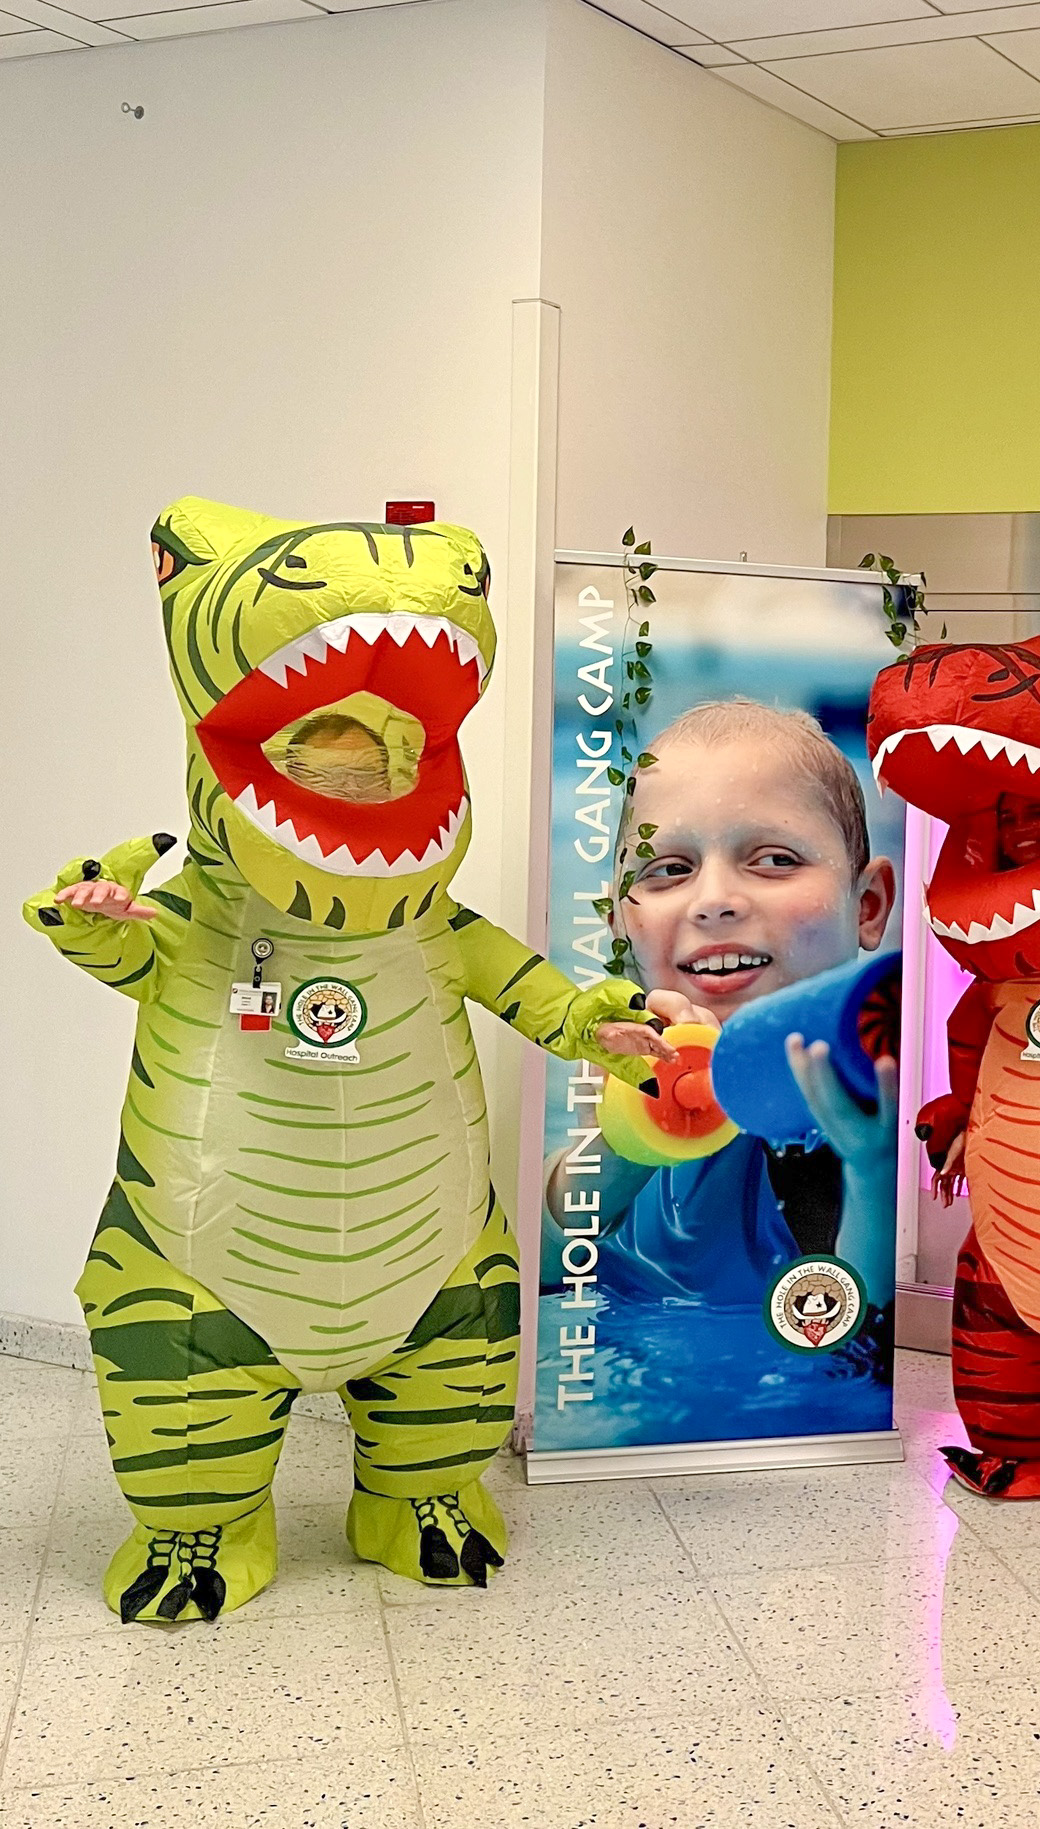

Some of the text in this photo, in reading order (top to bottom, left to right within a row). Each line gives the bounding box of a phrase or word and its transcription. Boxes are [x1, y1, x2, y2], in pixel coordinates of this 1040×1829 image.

[577, 585, 614, 717] CAMP
[574, 731, 613, 863] GANG
[331, 984, 349, 996] WALL
[286, 1049, 358, 1062] Hospital Outreach
[567, 1059, 604, 1112] TH
[565, 1127, 602, 1175] IN
[560, 1189, 600, 1309] HOLE
[776, 1264, 855, 1329] THE HOLE IN THE WALL GANG CAMP
[557, 1324, 596, 1411] THE
